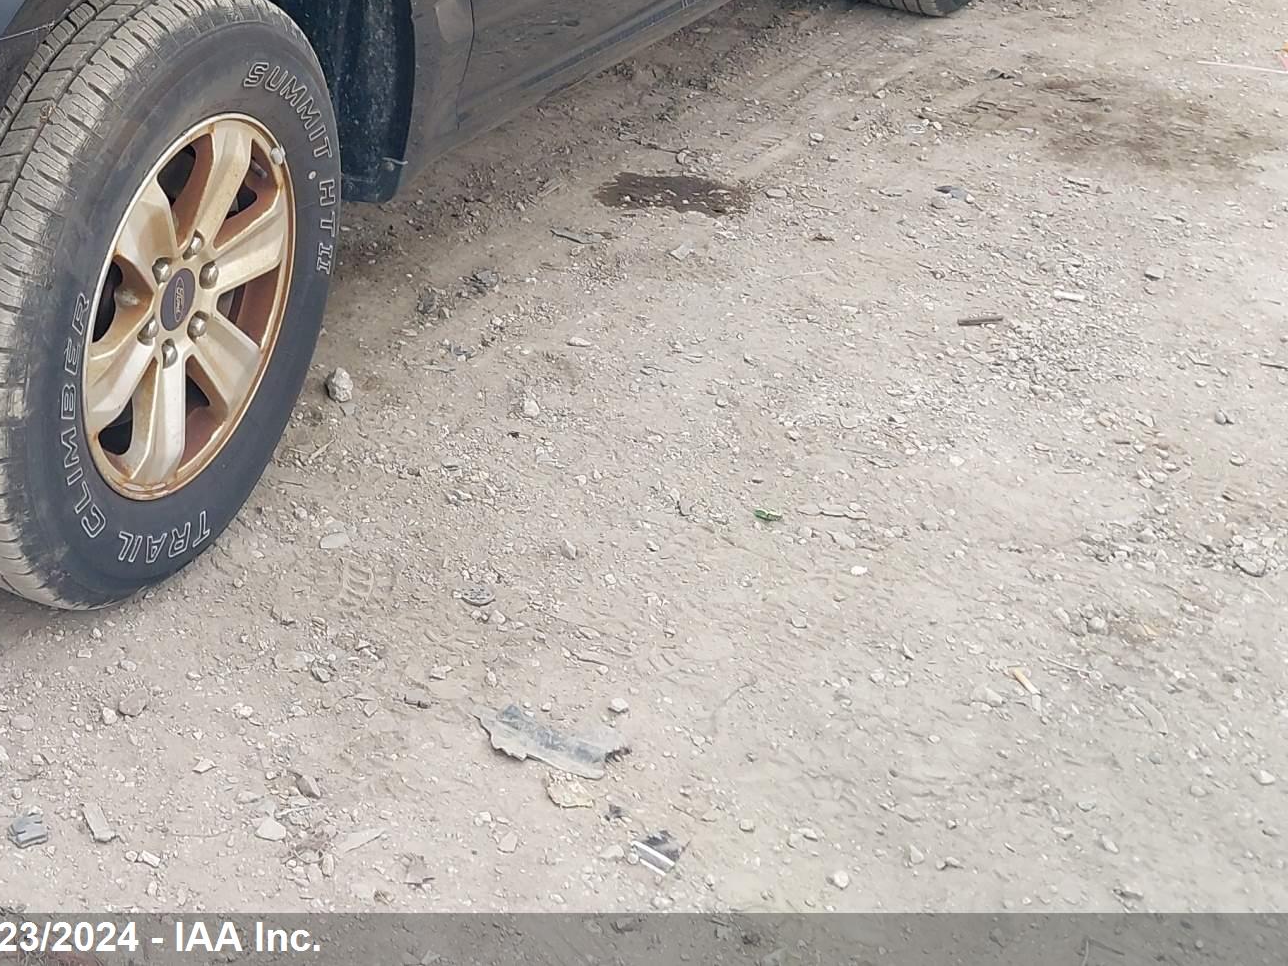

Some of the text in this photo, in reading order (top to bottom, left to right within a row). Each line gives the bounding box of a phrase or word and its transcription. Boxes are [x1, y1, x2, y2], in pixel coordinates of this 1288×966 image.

[243, 61, 333, 159] SUMMIT
[60, 292, 211, 564] TRAIL CLIMBER
